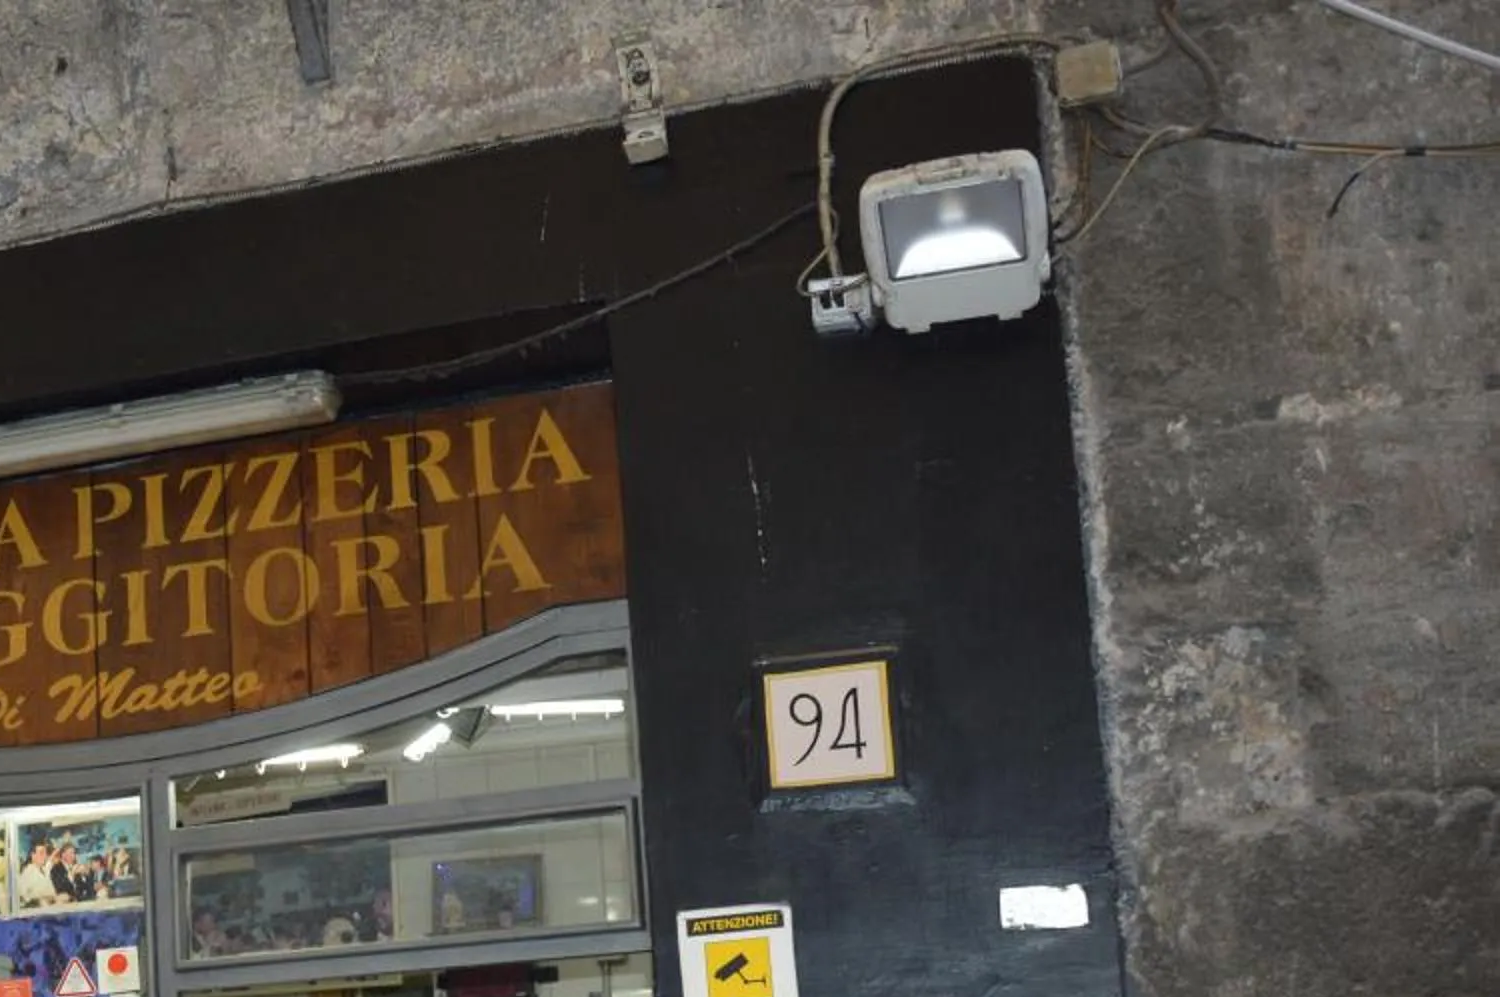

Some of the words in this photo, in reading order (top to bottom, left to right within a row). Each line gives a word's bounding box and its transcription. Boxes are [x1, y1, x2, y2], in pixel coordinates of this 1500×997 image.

[73, 407, 591, 558] PIZZERIA
[50, 668, 263, 726] Matteo
[789, 688, 867, 766] 94
[692, 913, 779, 934] ATTENZIONE!
